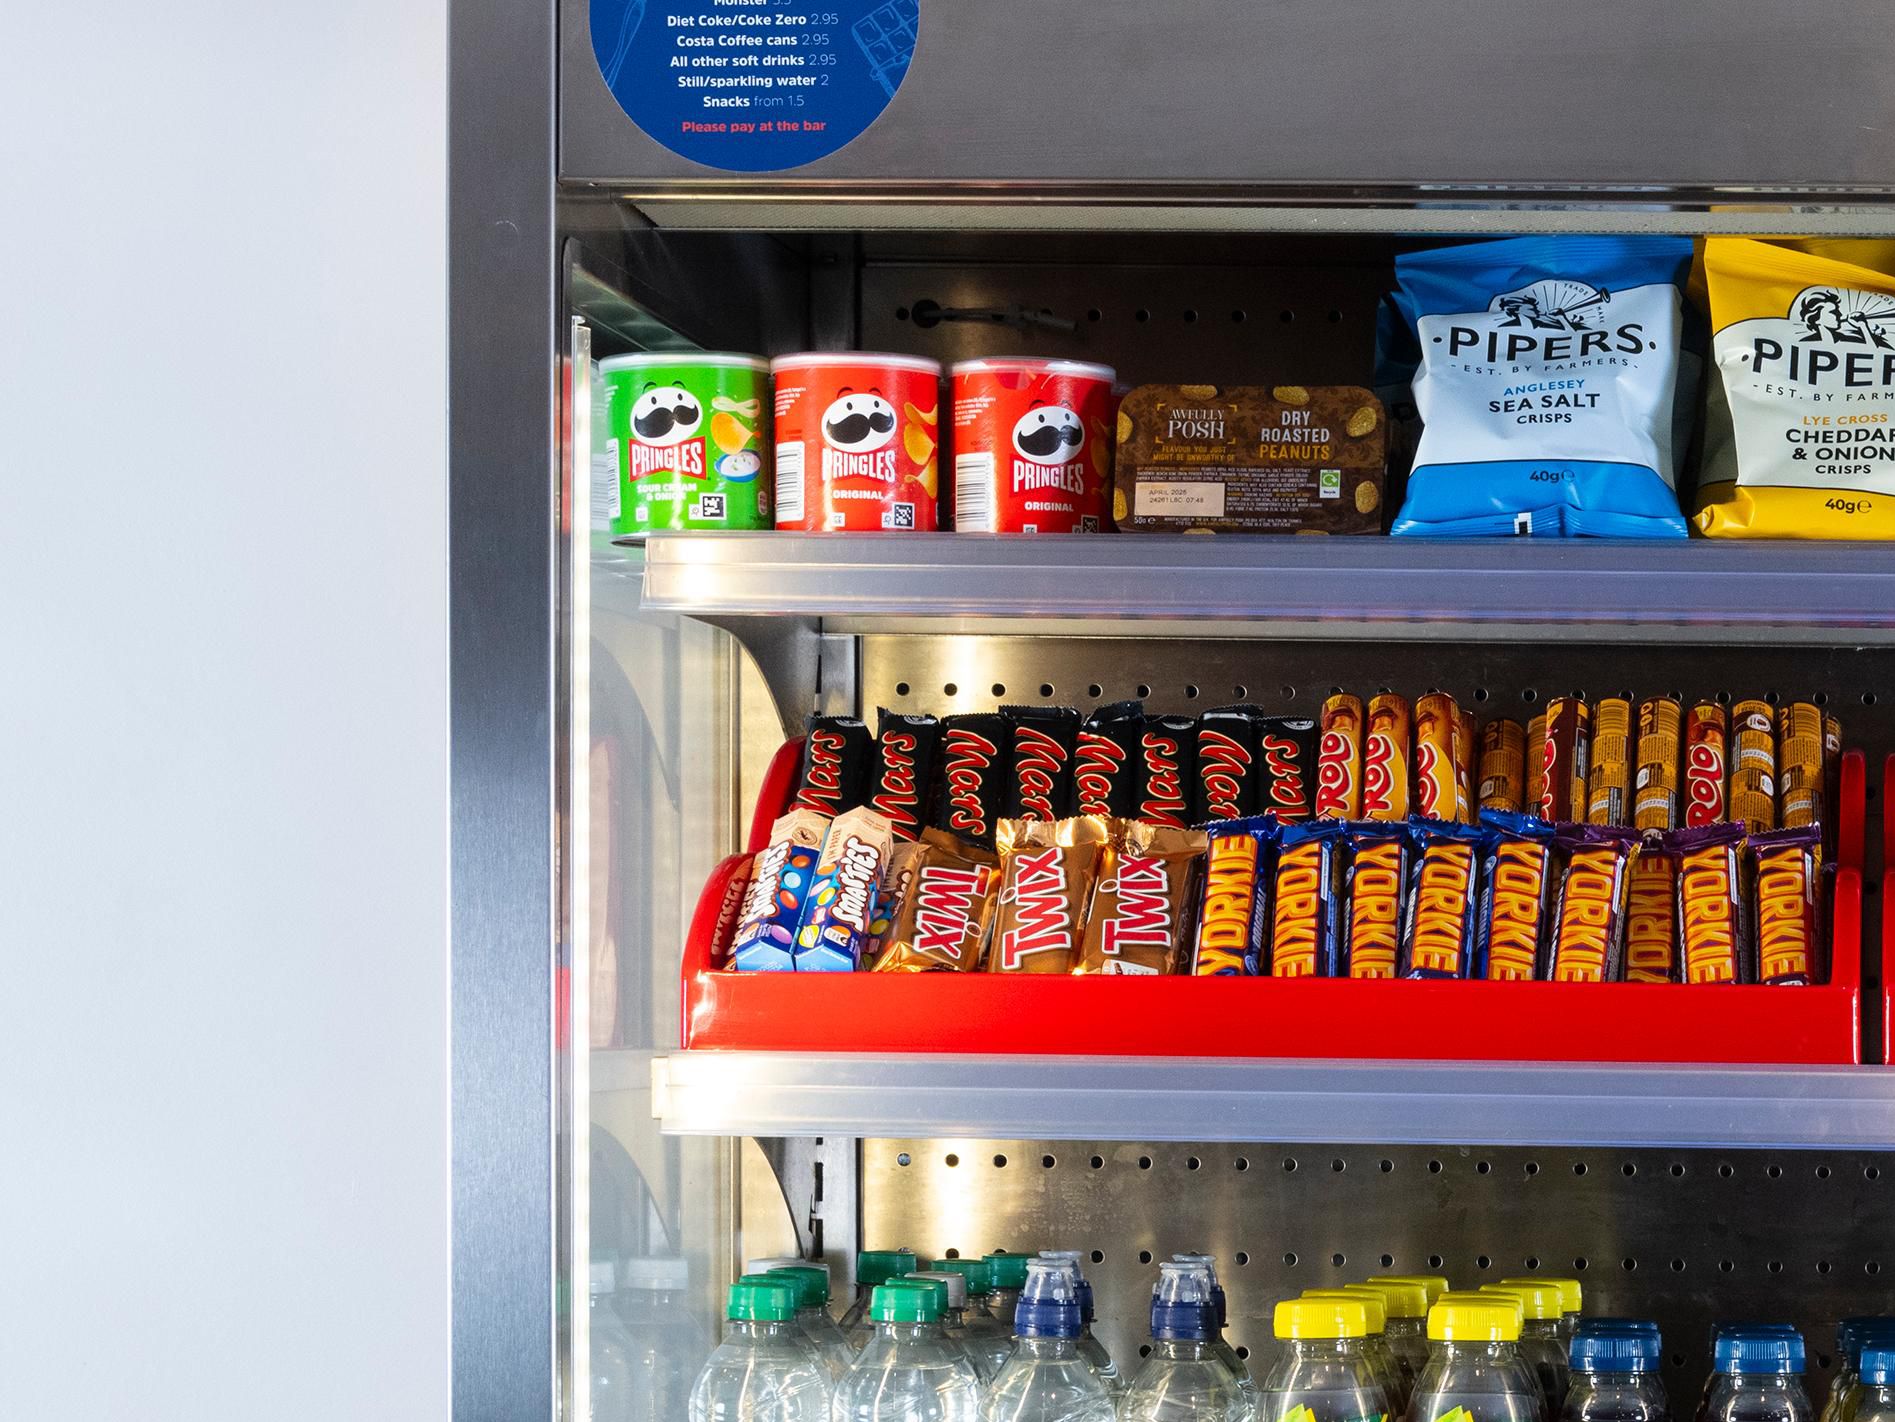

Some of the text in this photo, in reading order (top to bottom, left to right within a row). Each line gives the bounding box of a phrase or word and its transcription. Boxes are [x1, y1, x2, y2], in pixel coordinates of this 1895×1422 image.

[667, 13, 839, 27] Diet Coke/Coke Zero 2.95
[676, 34, 830, 47] Costa Coffee cans 2.95
[669, 54, 837, 68] All other soft drinks 2.95
[677, 74, 829, 89] Still/sparkling water 2
[703, 95, 805, 108] Snacks from 1.5
[681, 119, 827, 135] Please pay at the bar
[1448, 323, 1644, 363] PIPERS
[1503, 379, 1586, 397] ANGLESEY
[1488, 393, 1601, 414] SEA SALT
[1170, 408, 1225, 420] AWFULLY
[1281, 410, 1311, 427] DRY
[1516, 412, 1573, 425] CRISPS
[1803, 413, 1889, 426] LYE CROSS
[1167, 421, 1225, 439] POSH
[1260, 428, 1330, 443] ROASTED
[631, 443, 703, 476] PRINGLES
[1259, 444, 1330, 461] PEANUTS
[1791, 446, 1895, 462] & ONION
[821, 449, 896, 482] PRINGLES
[1815, 463, 1873, 476] CRISPS
[1012, 461, 1085, 495] PRINGLES
[833, 489, 884, 501] ORIGINAL
[1024, 501, 1074, 513] ORIGINAL
[946, 728, 998, 835] Mars
[832, 835, 881, 933] SMARTIES
[1197, 834, 1258, 976] YORKIE
[1411, 844, 1473, 972] YORKIE
